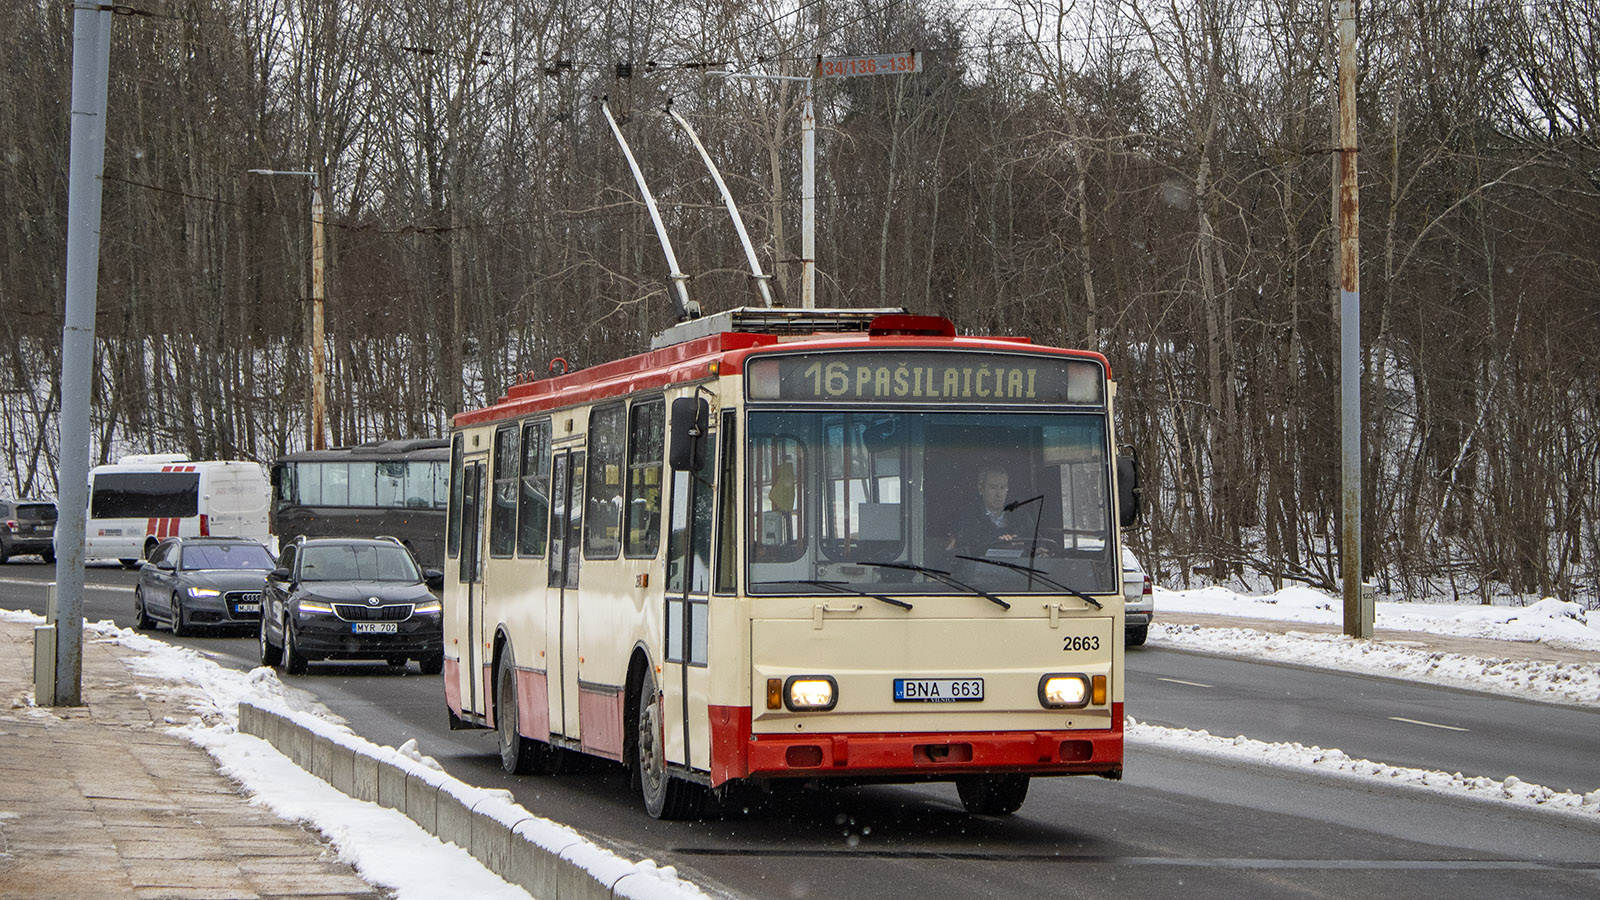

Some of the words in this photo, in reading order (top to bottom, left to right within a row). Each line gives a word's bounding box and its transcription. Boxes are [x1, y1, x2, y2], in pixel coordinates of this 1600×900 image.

[805, 361, 849, 396] 16
[856, 362, 1037, 398] PAŠILAIČIAI
[357, 624, 376, 632] MYR
[381, 624, 396, 632] 702
[1063, 636, 1100, 651] 2663
[906, 682, 940, 697] BNA
[951, 682, 980, 697] 663
